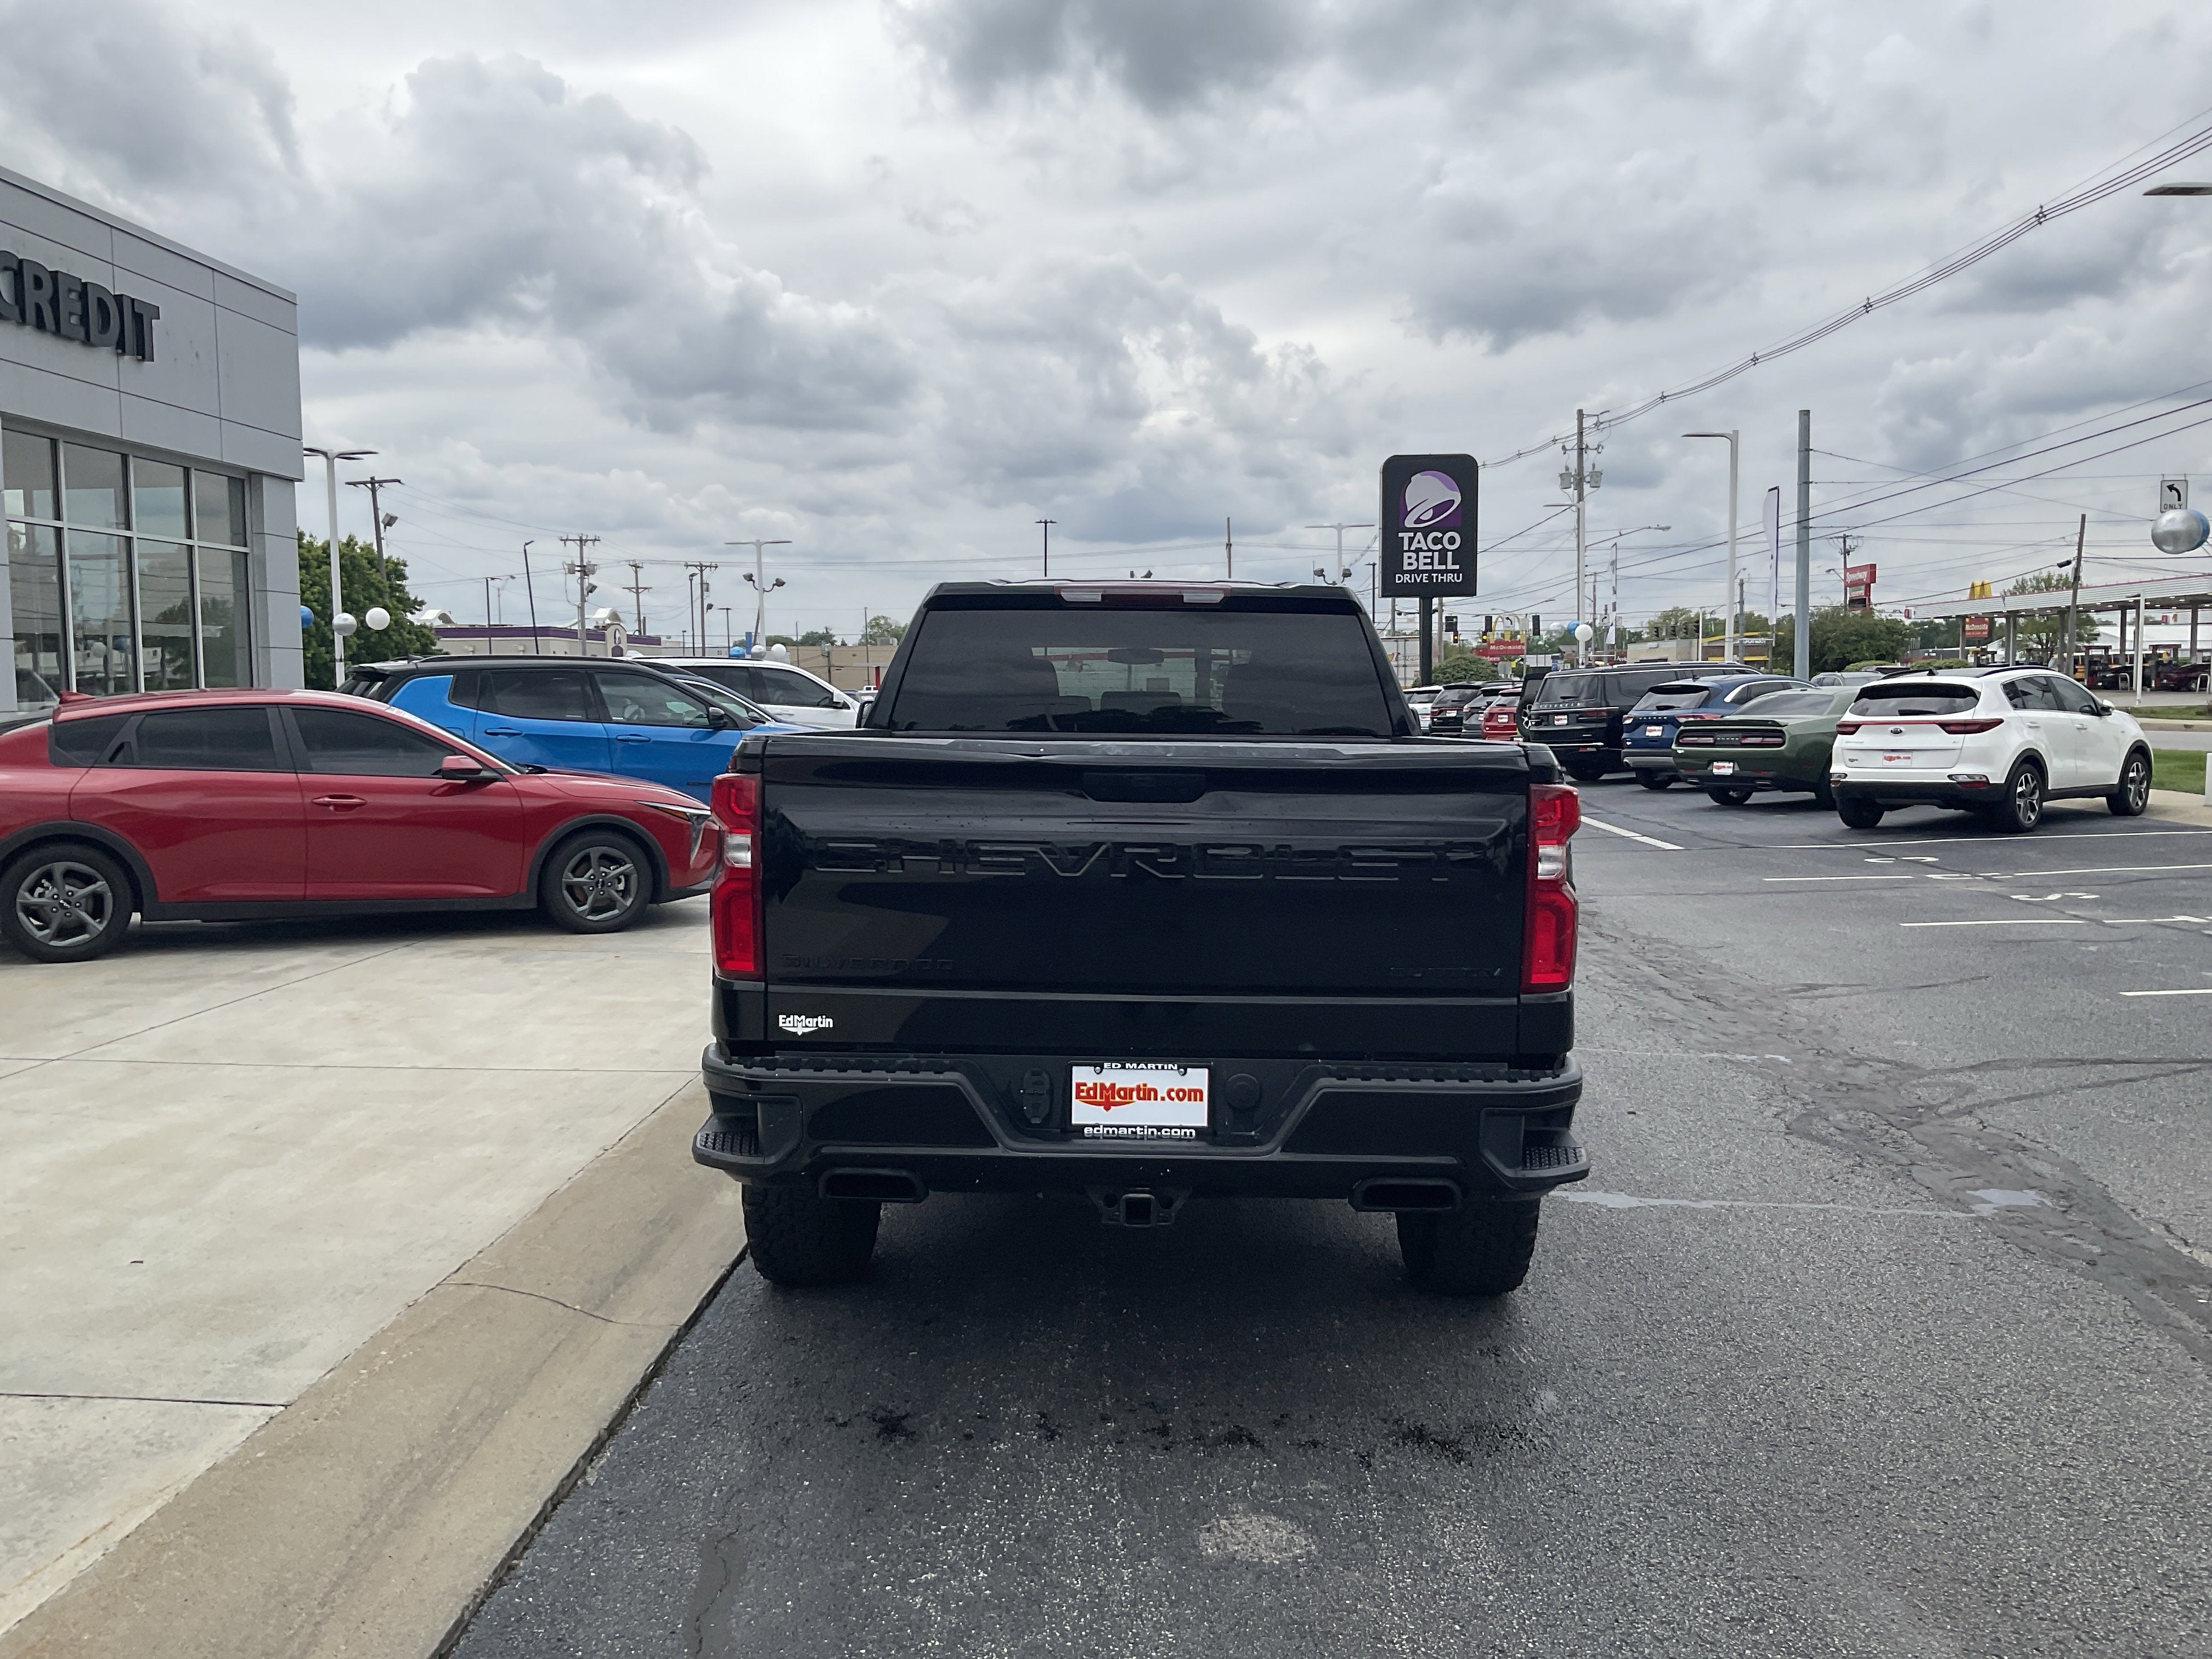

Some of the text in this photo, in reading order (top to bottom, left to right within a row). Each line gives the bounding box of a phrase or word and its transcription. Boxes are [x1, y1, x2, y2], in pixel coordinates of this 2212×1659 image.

[1398, 532, 1460, 550] TACO
[1403, 552, 1459, 570] BELL
[1395, 573, 1463, 583] DRIVE THRU
[815, 839, 1477, 881] CHEVROLET
[779, 1015, 833, 1028] EdMartin
[1075, 1082, 1204, 1102] EdMartin.com
[1084, 1125, 1195, 1136] edmartin.com
